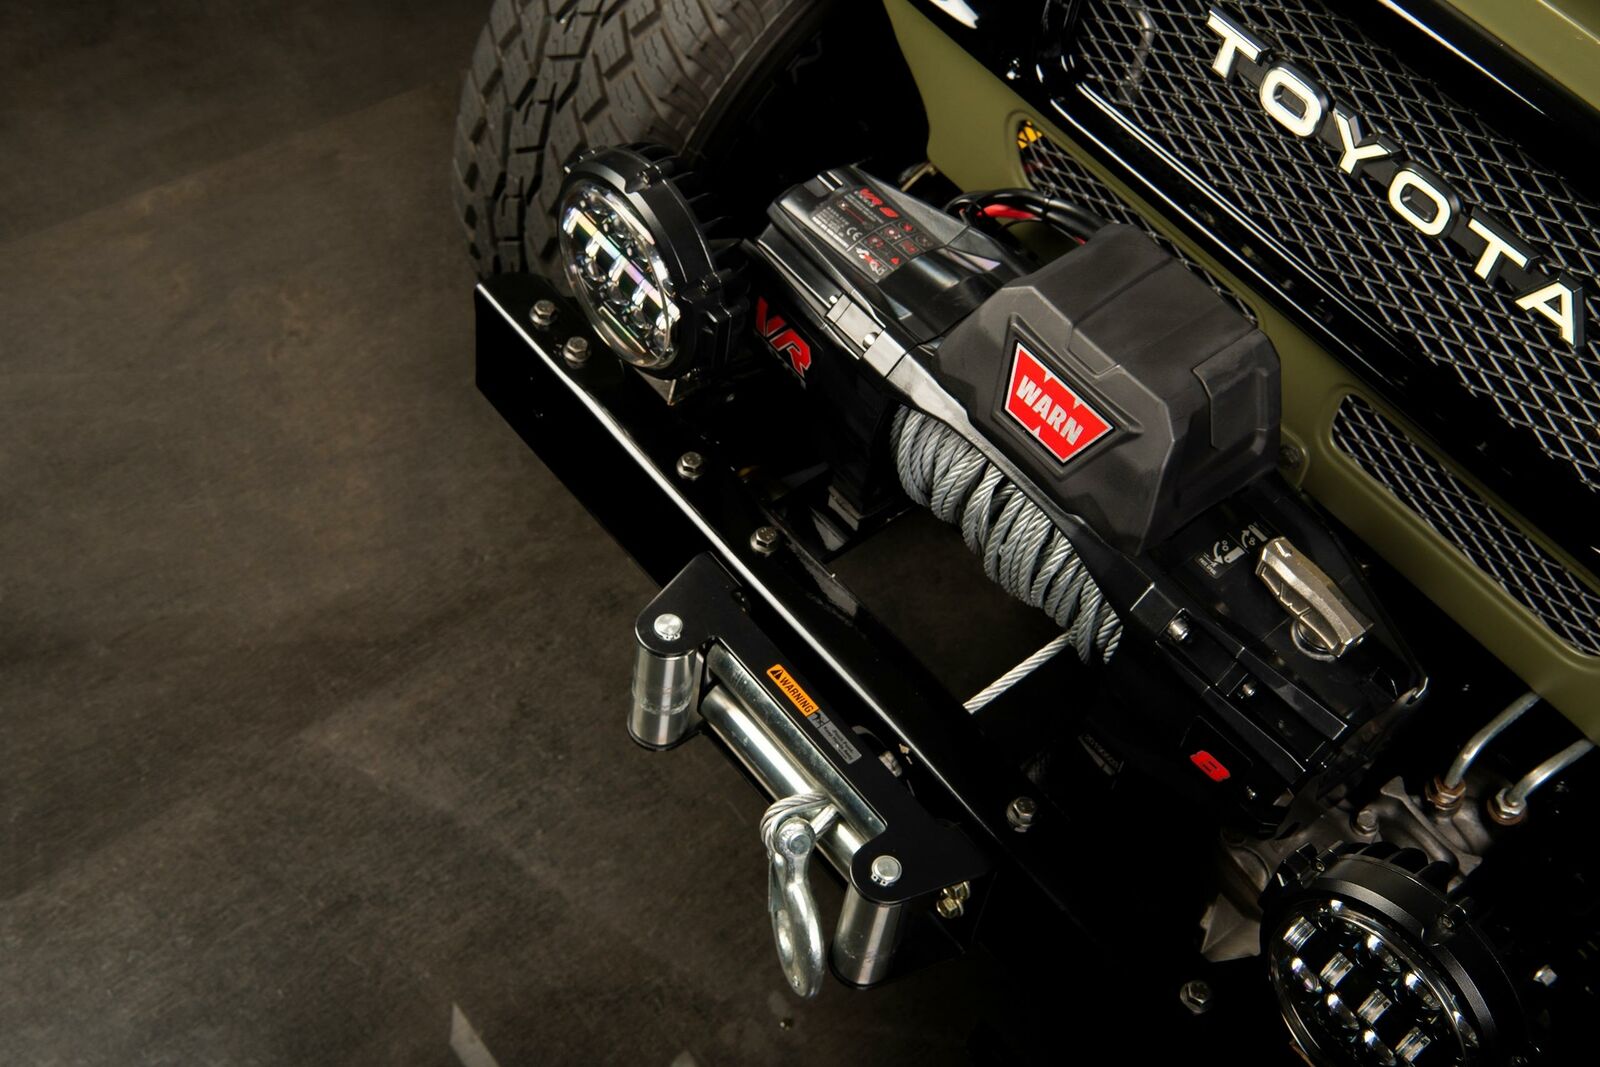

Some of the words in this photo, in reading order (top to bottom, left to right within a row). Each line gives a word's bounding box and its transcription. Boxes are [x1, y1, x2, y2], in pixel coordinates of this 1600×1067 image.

[1206, 8, 1583, 347] TOYOTA
[755, 296, 812, 378] VR
[1015, 375, 1084, 446] WARN
[780, 677, 814, 714] WARNING
[1189, 750, 1231, 782] 8
